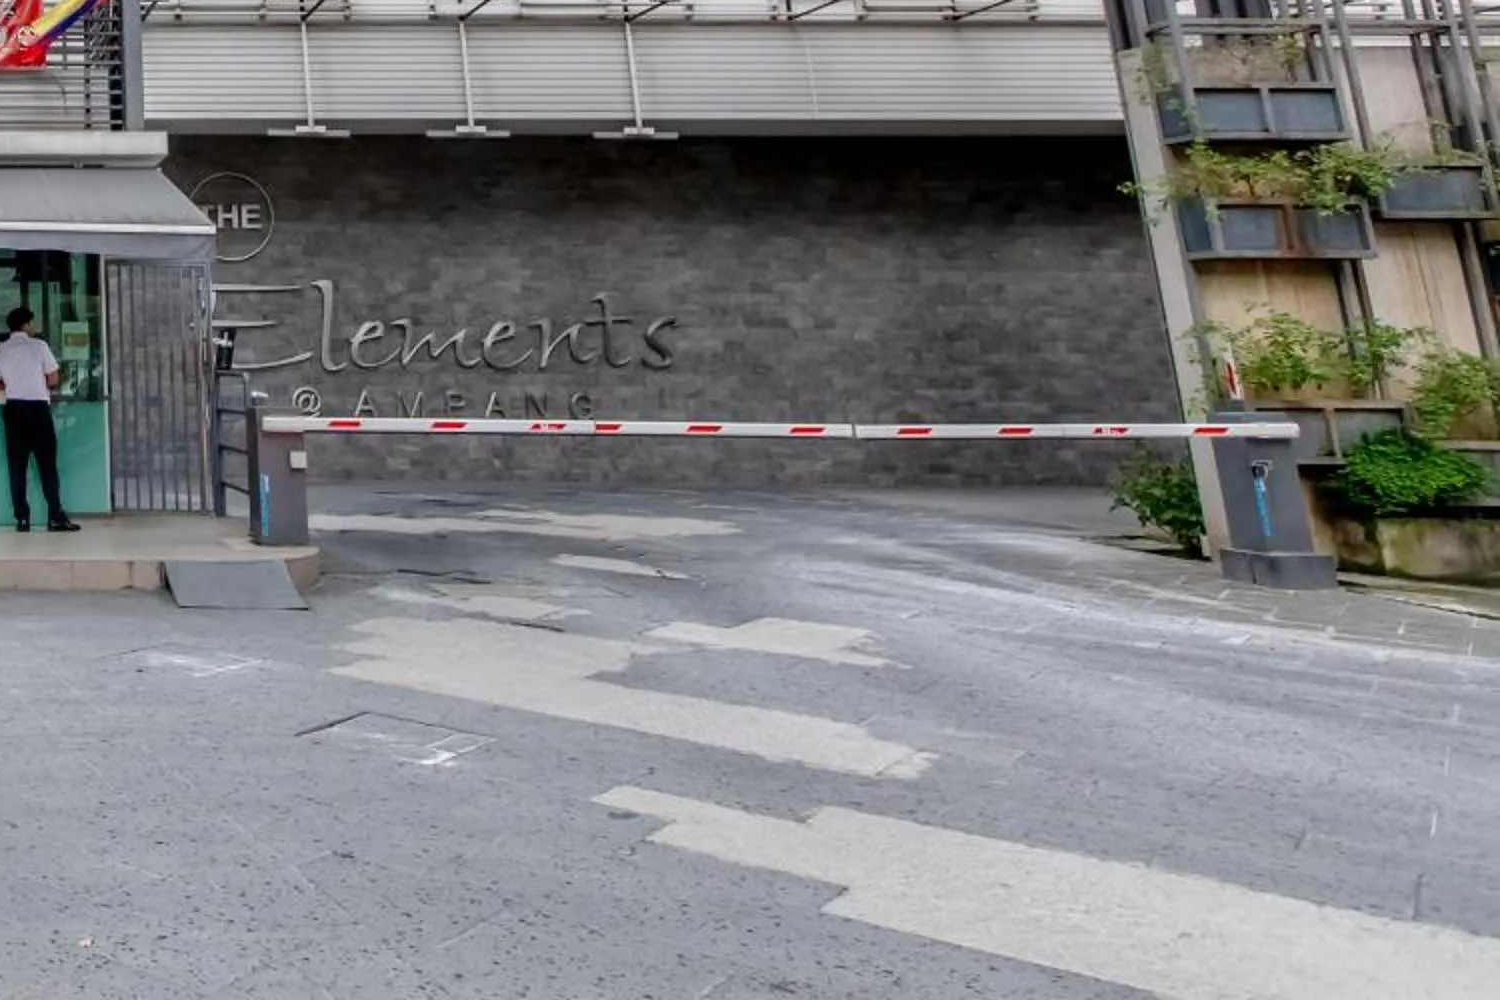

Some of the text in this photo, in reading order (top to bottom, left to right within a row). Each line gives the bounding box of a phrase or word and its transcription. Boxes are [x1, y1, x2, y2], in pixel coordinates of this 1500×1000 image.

[198, 203, 264, 230] THE
[200, 278, 681, 373] Elements
[292, 386, 596, 418] @ AMPANG
